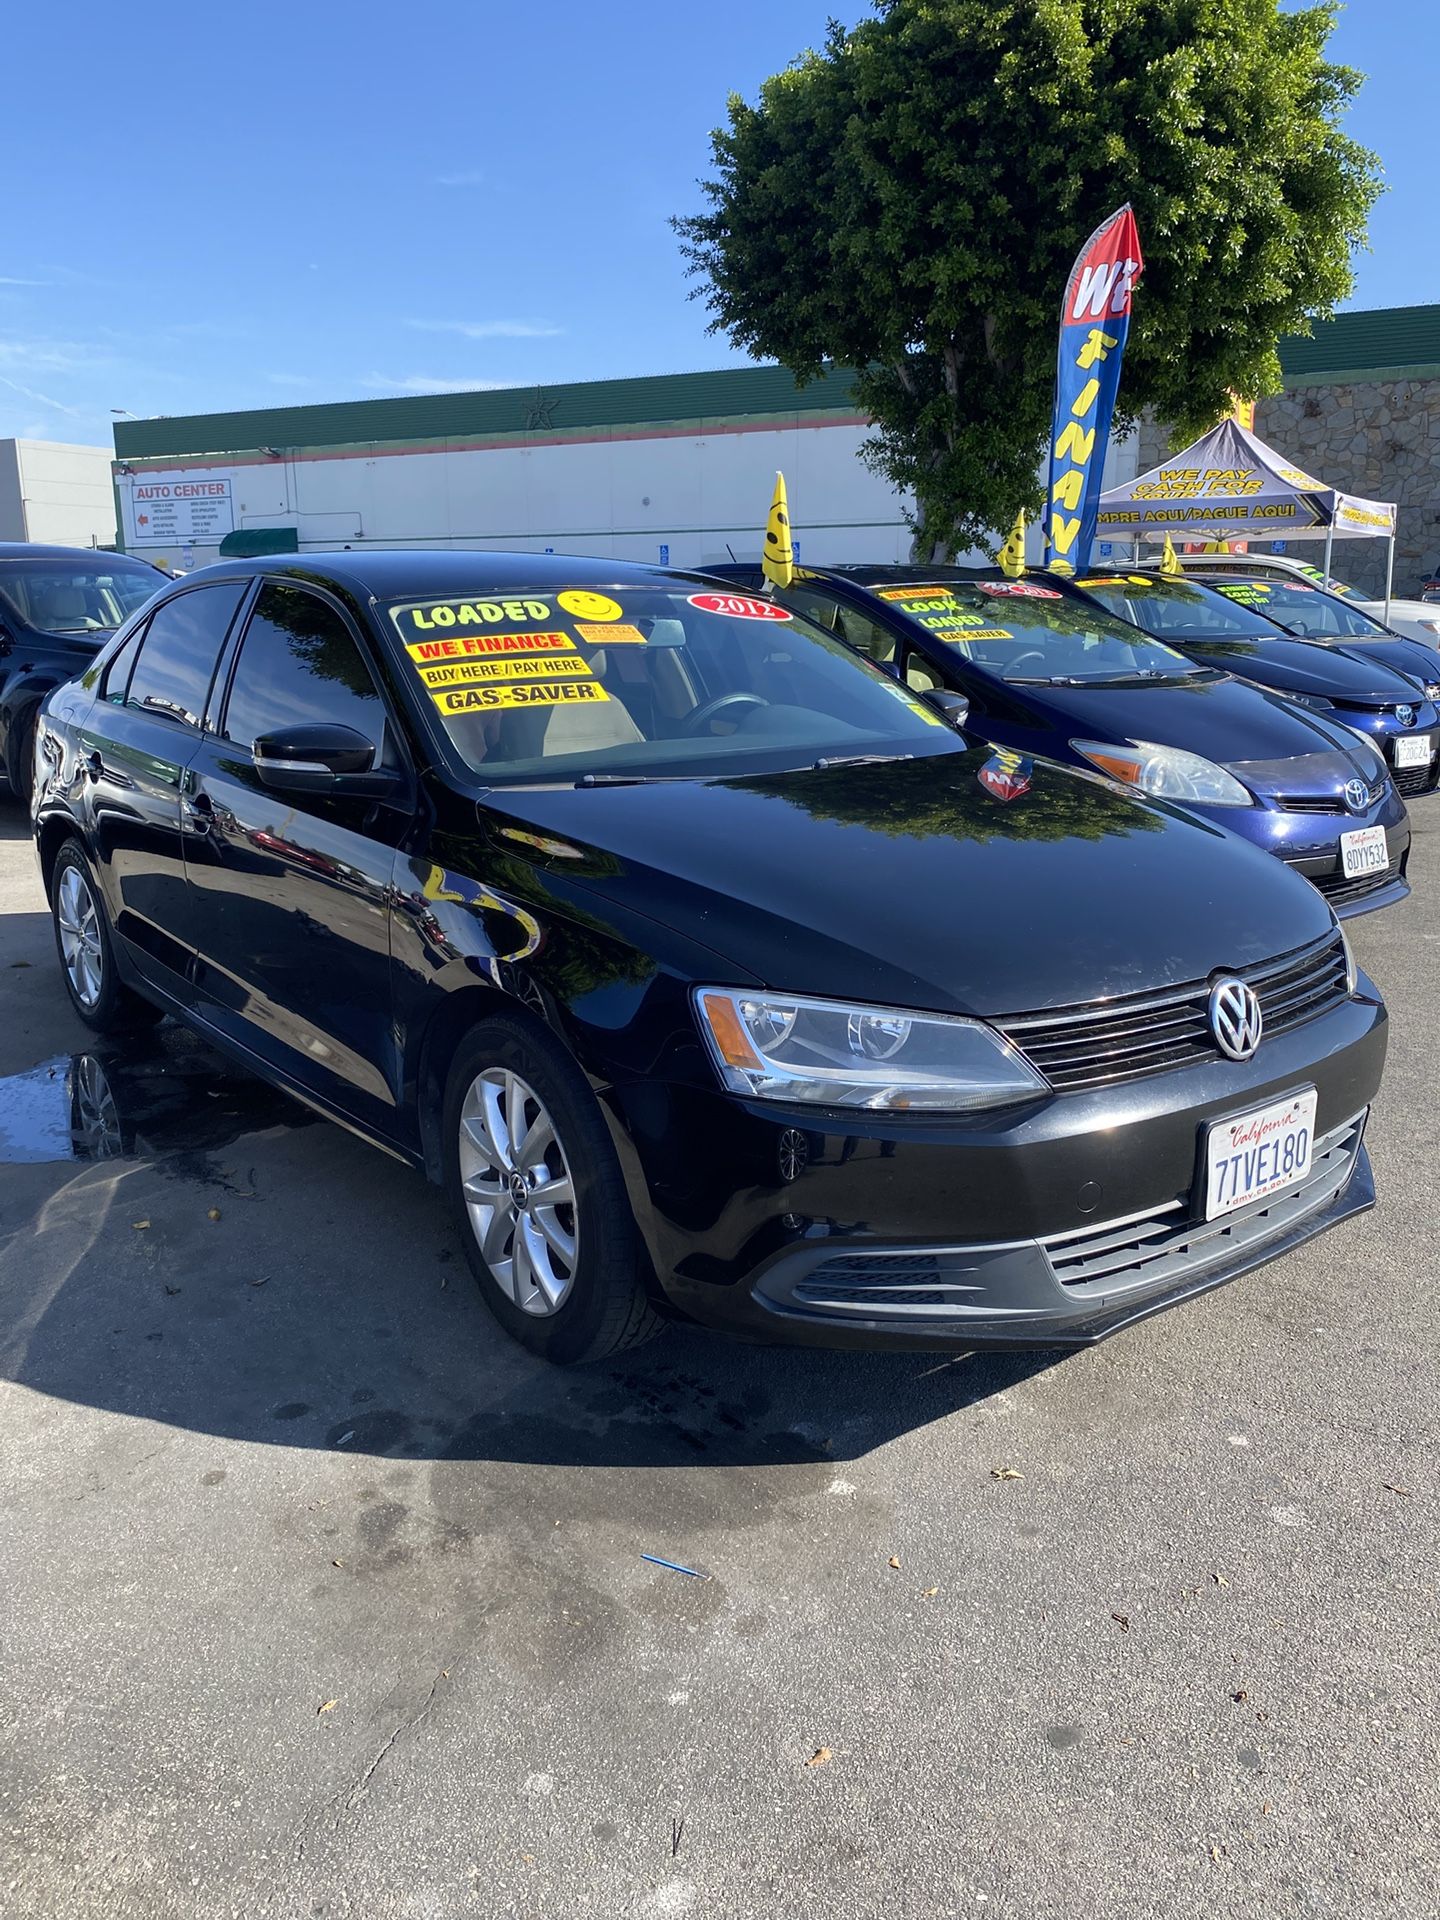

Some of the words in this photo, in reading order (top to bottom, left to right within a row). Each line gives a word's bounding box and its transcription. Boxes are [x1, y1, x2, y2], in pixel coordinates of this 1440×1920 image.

[1135, 481, 1205, 493] CASH
[1208, 480, 1264, 491] FOR
[1160, 469, 1201, 481] WE
[1203, 469, 1255, 481] PAY
[137, 486, 170, 499] AUTO
[173, 483, 225, 497] CENTER
[1143, 506, 1248, 522] AQUI/PAGUE
[1250, 504, 1296, 518] AQUI
[411, 600, 550, 629] LOADED
[710, 597, 775, 616] 2012
[900, 601, 963, 613] LOOK
[918, 615, 984, 629] LOADED
[417, 641, 458, 659] WE
[461, 634, 566, 654] FINANCE
[426, 669, 456, 683] BUY
[461, 664, 500, 679] HERE
[513, 661, 540, 674] PAY
[543, 659, 582, 672] HERE
[445, 684, 595, 710] GAS-SAVER
[1346, 843, 1386, 871] 8DYY532
[1232, 1111, 1297, 1148] California
[1216, 1127, 1308, 1203] 7TVE180
[1232, 1177, 1287, 1206] dmv.ca.gov
